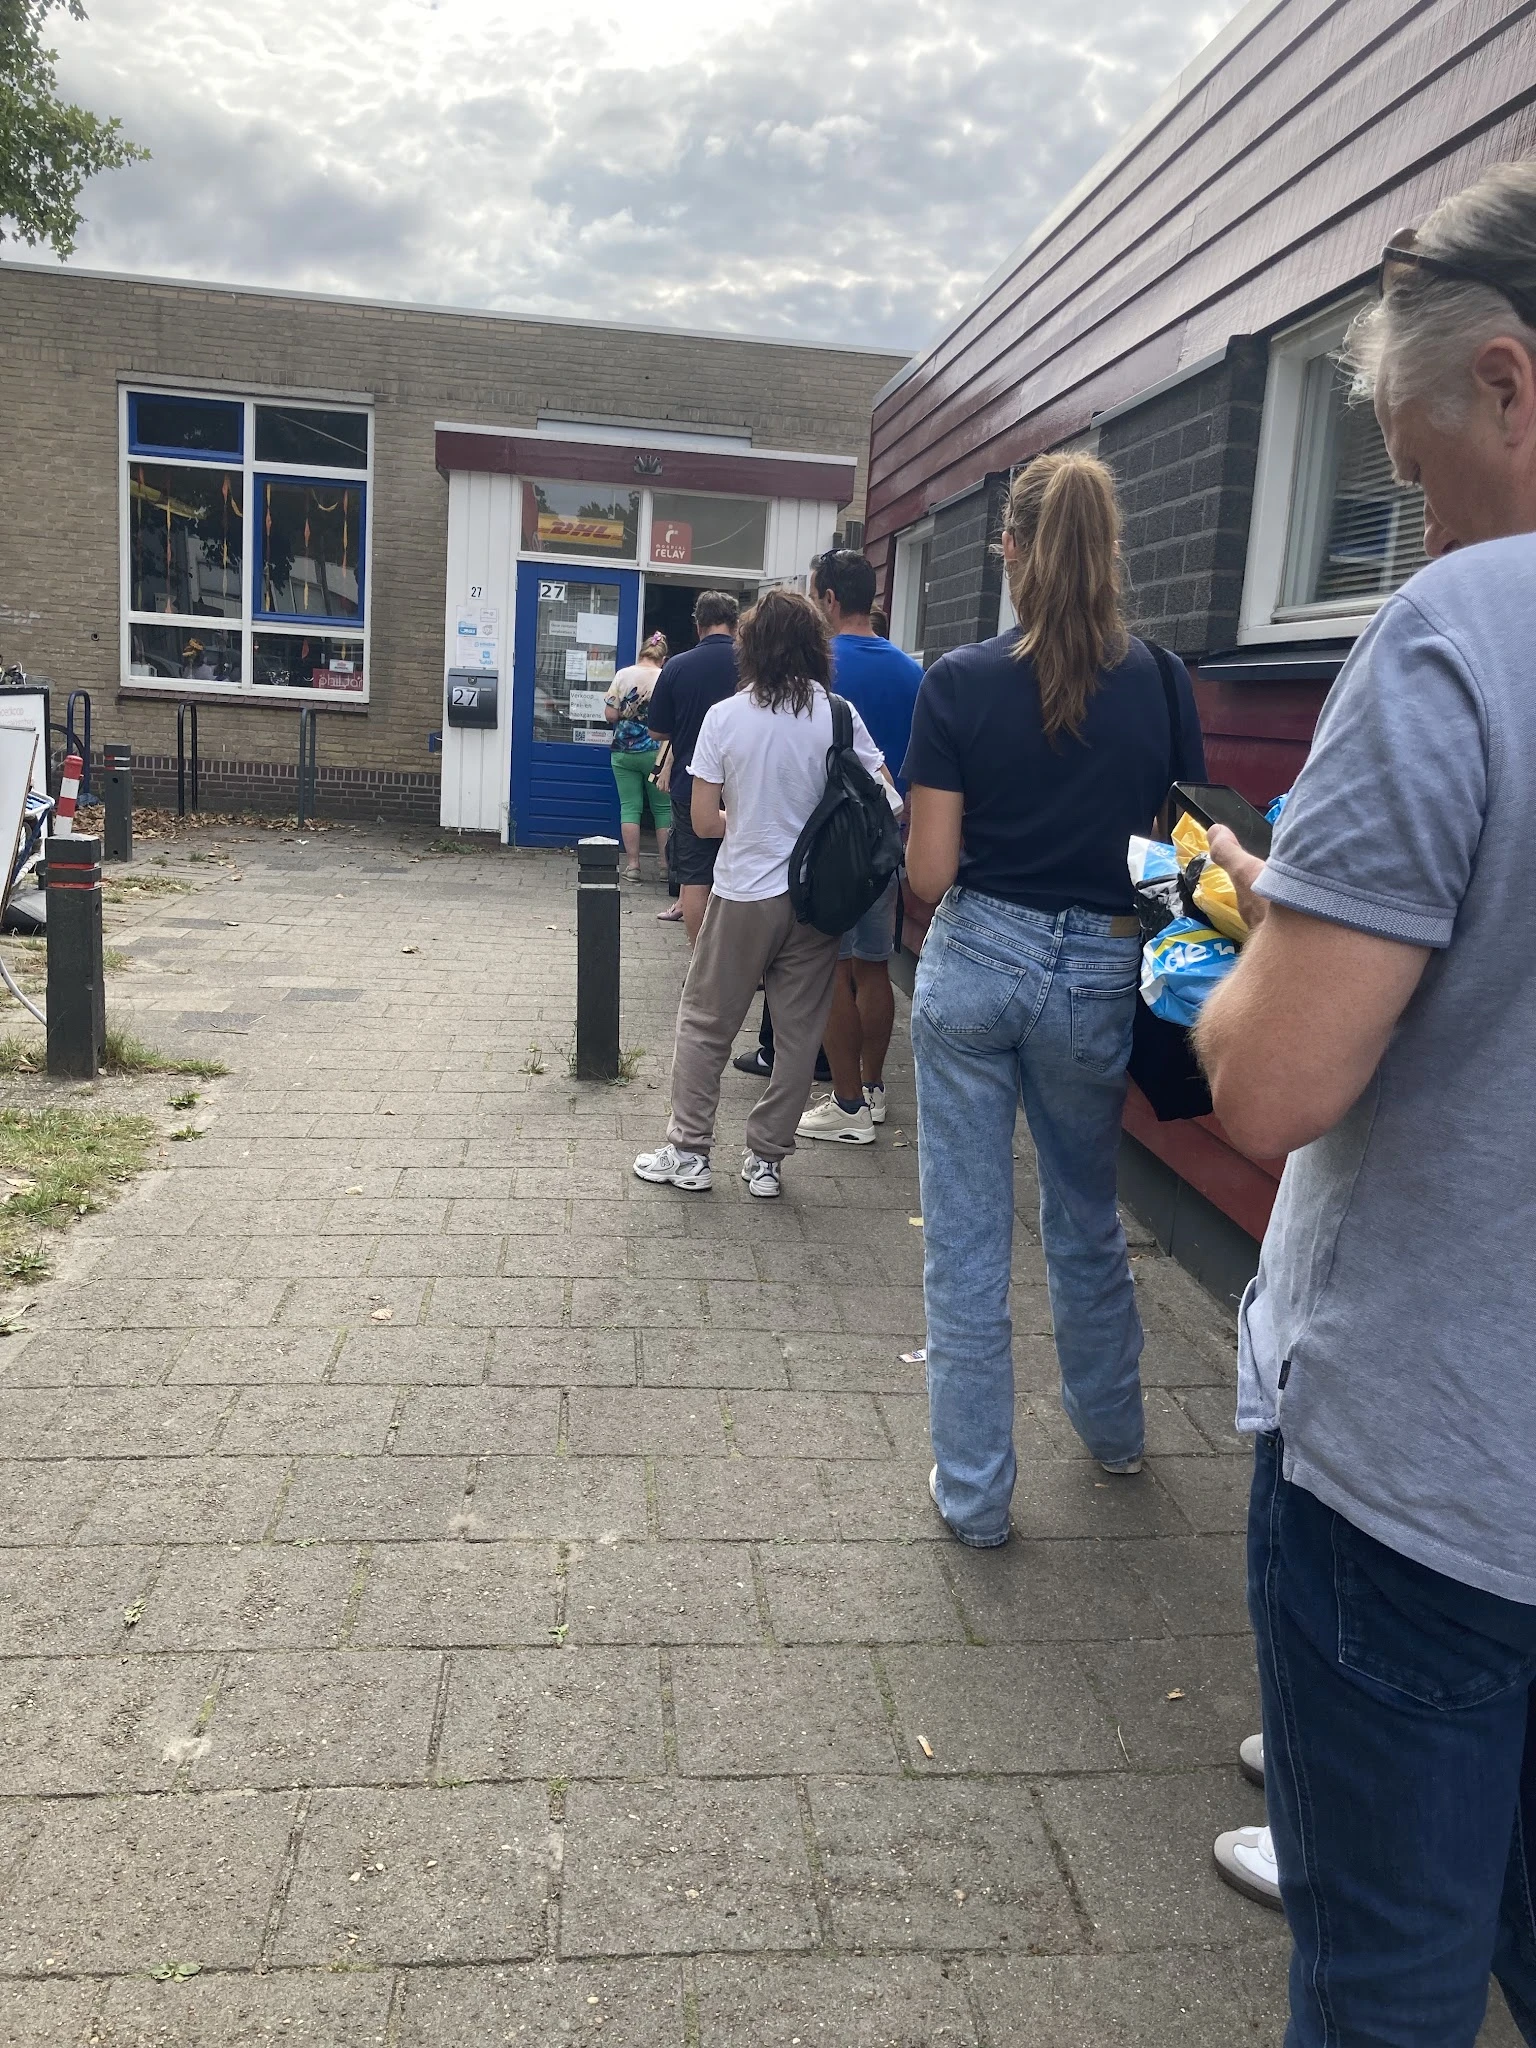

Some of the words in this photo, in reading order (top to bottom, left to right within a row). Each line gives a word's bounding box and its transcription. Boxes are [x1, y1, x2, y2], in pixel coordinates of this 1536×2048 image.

[550, 521, 611, 540] DHL
[471, 586, 482, 598] 27
[541, 584, 564, 599] 27
[453, 689, 477, 706] 27
[570, 692, 594, 700] Verkoop
